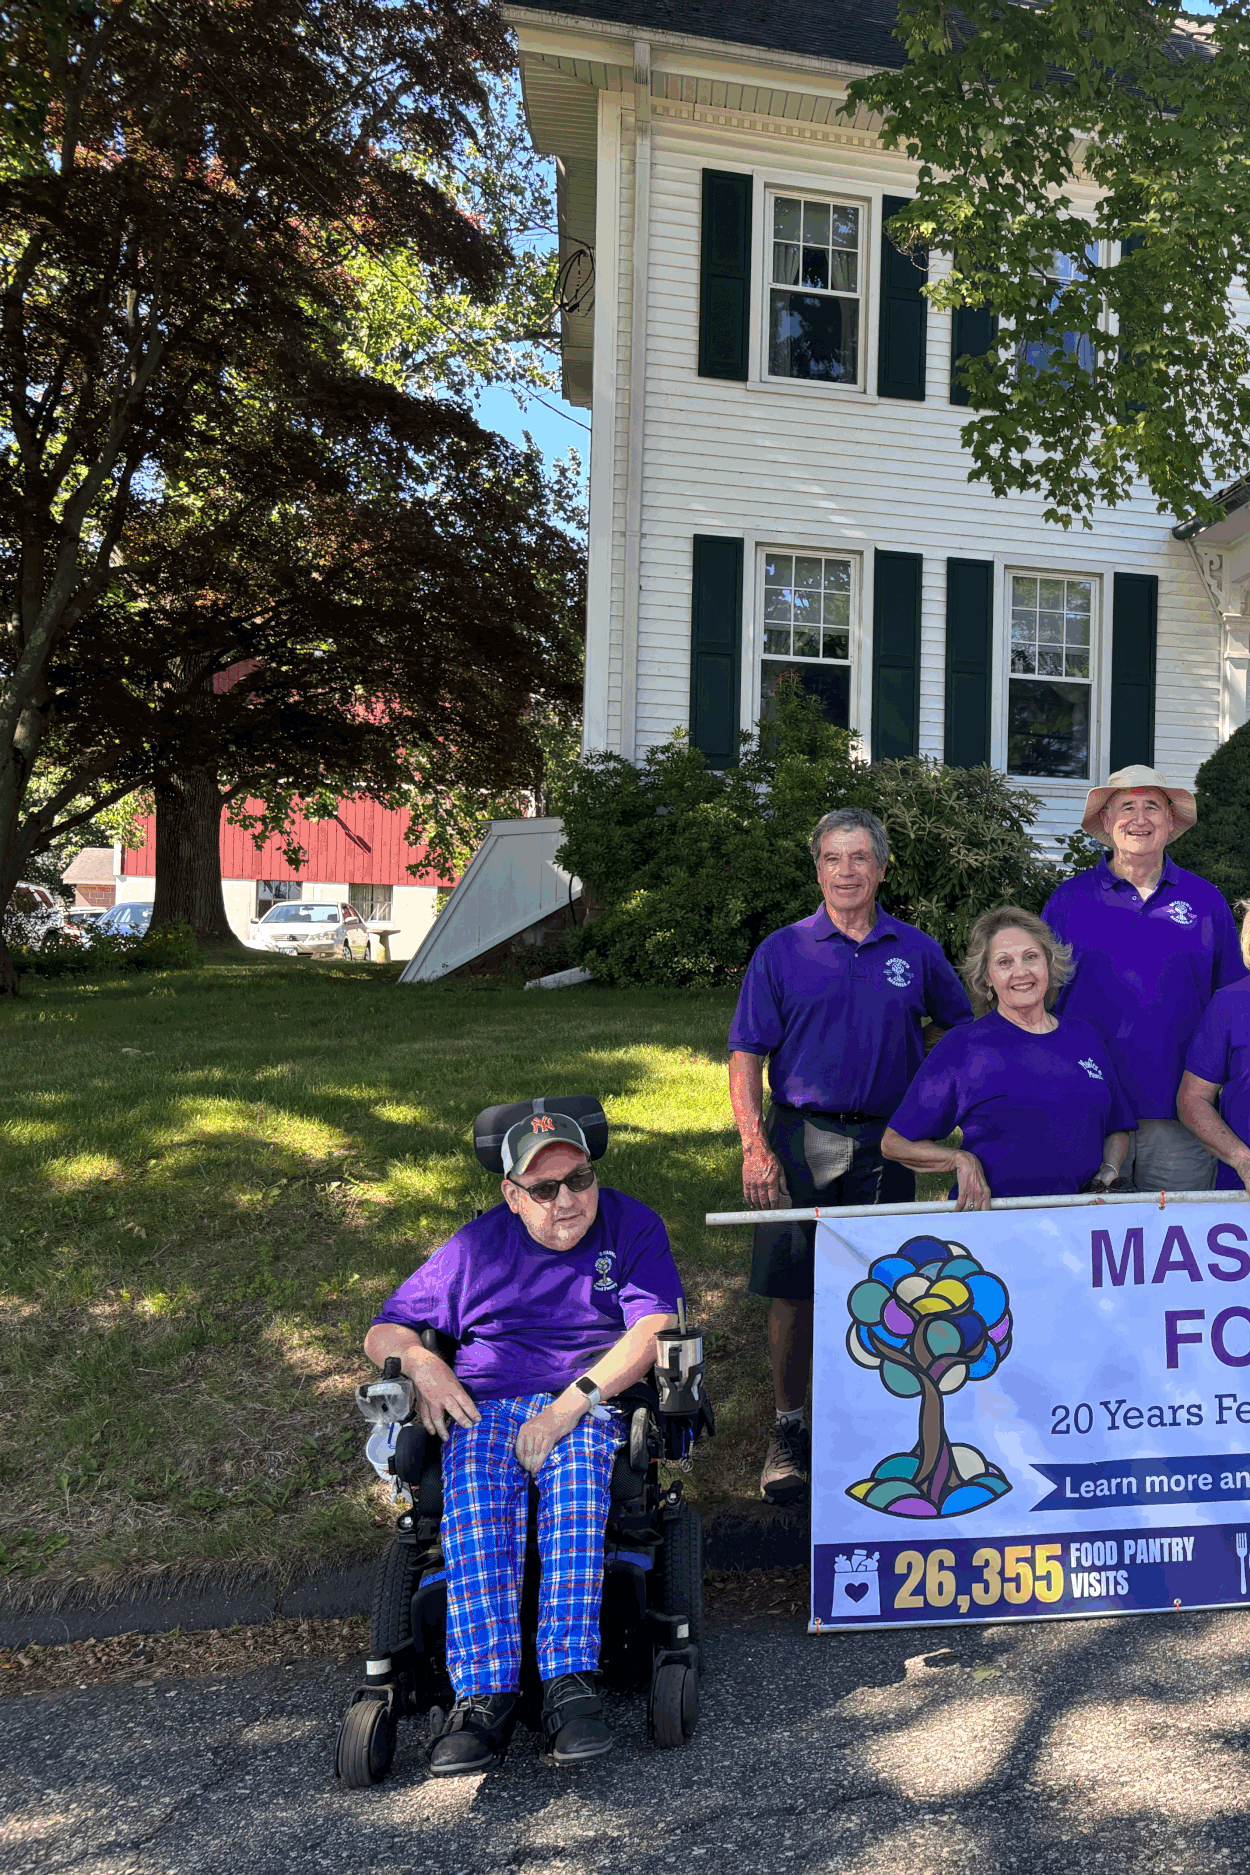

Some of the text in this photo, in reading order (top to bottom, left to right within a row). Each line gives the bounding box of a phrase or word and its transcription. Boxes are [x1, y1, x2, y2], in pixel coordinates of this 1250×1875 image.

[1051, 1403, 1093, 1435] 20
[1100, 1399, 1204, 1431] Years
[1065, 1476, 1137, 1498] Learn
[1145, 1473, 1213, 1493] more
[1070, 1536, 1195, 1568] FOOD PANTRY
[894, 1543, 1064, 1614] 26,355
[1070, 1570, 1129, 1598] VISITS
